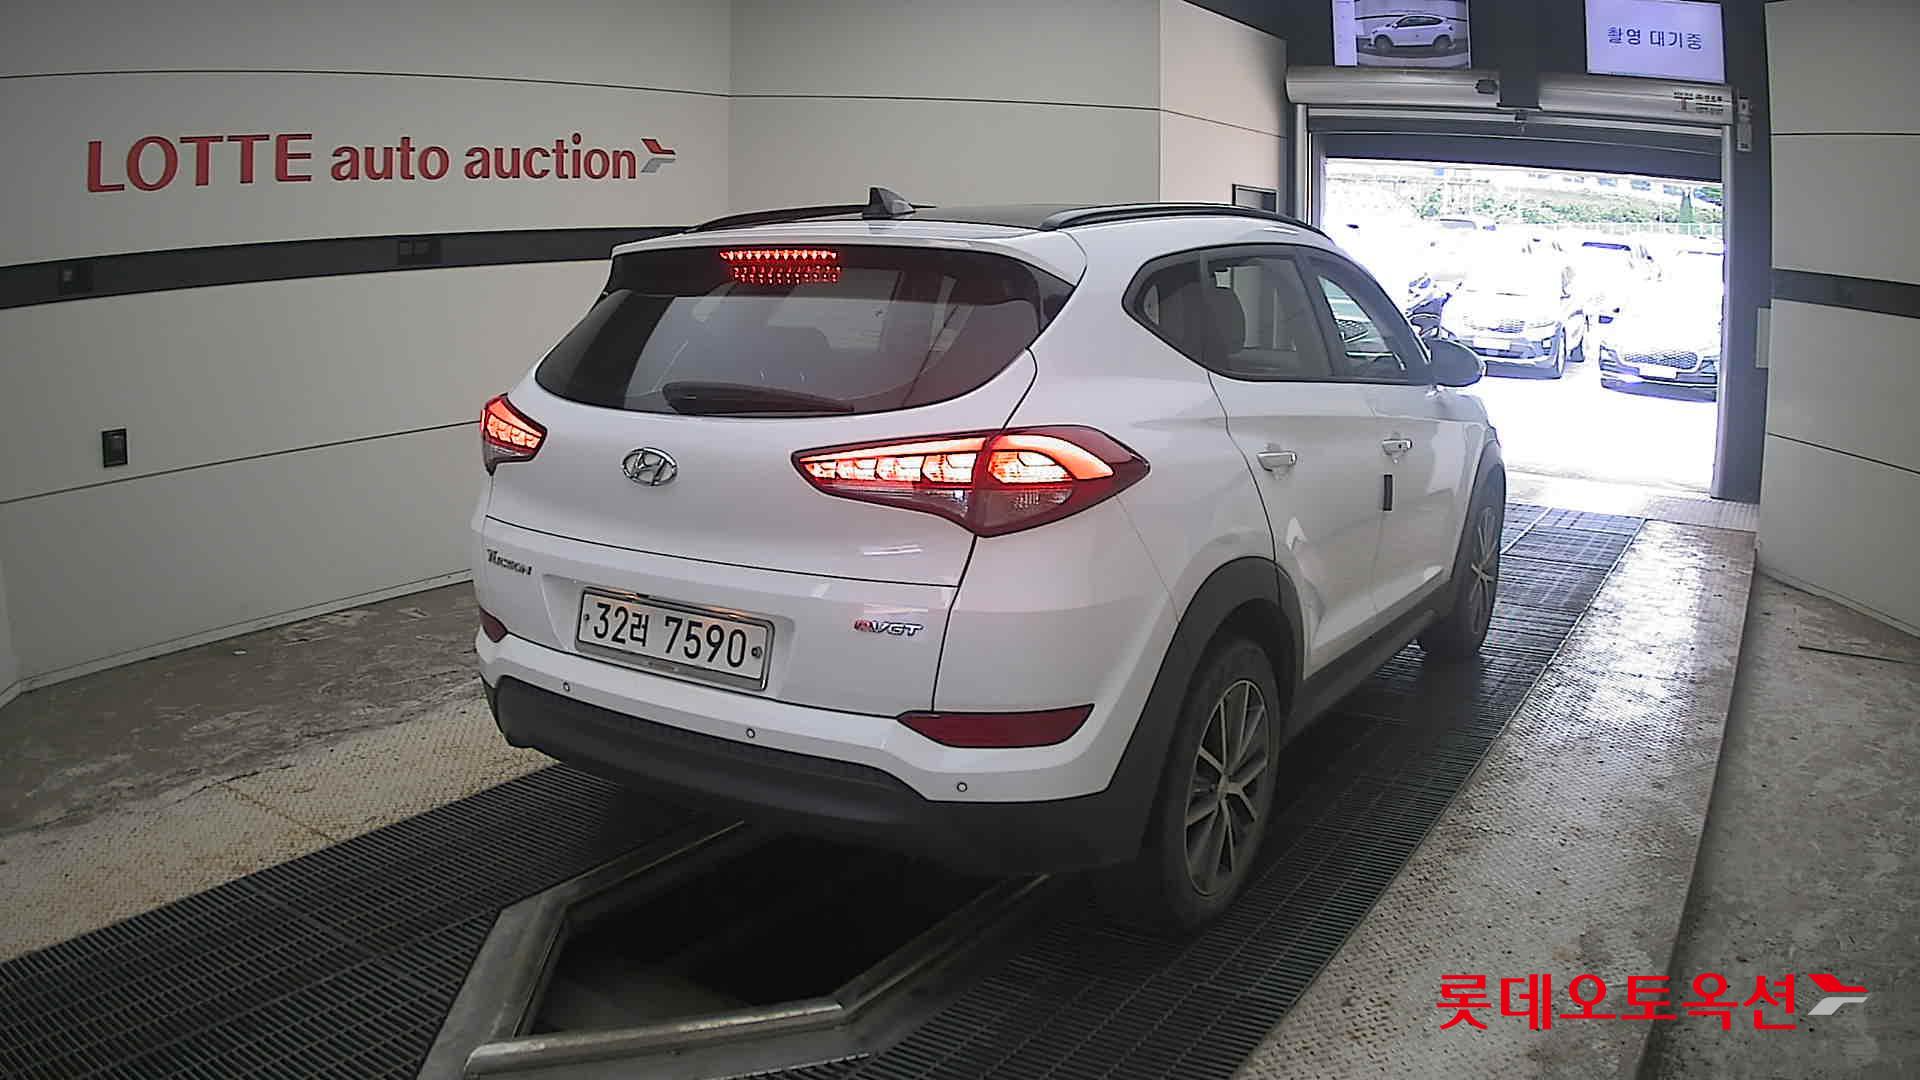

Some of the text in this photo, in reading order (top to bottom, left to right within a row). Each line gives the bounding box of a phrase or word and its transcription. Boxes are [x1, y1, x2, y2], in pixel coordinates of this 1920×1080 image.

[1650, 31, 1702, 50] 대기중
[88, 132, 637, 192] LOTTE auto auction
[593, 602, 747, 667] 32러 7590
